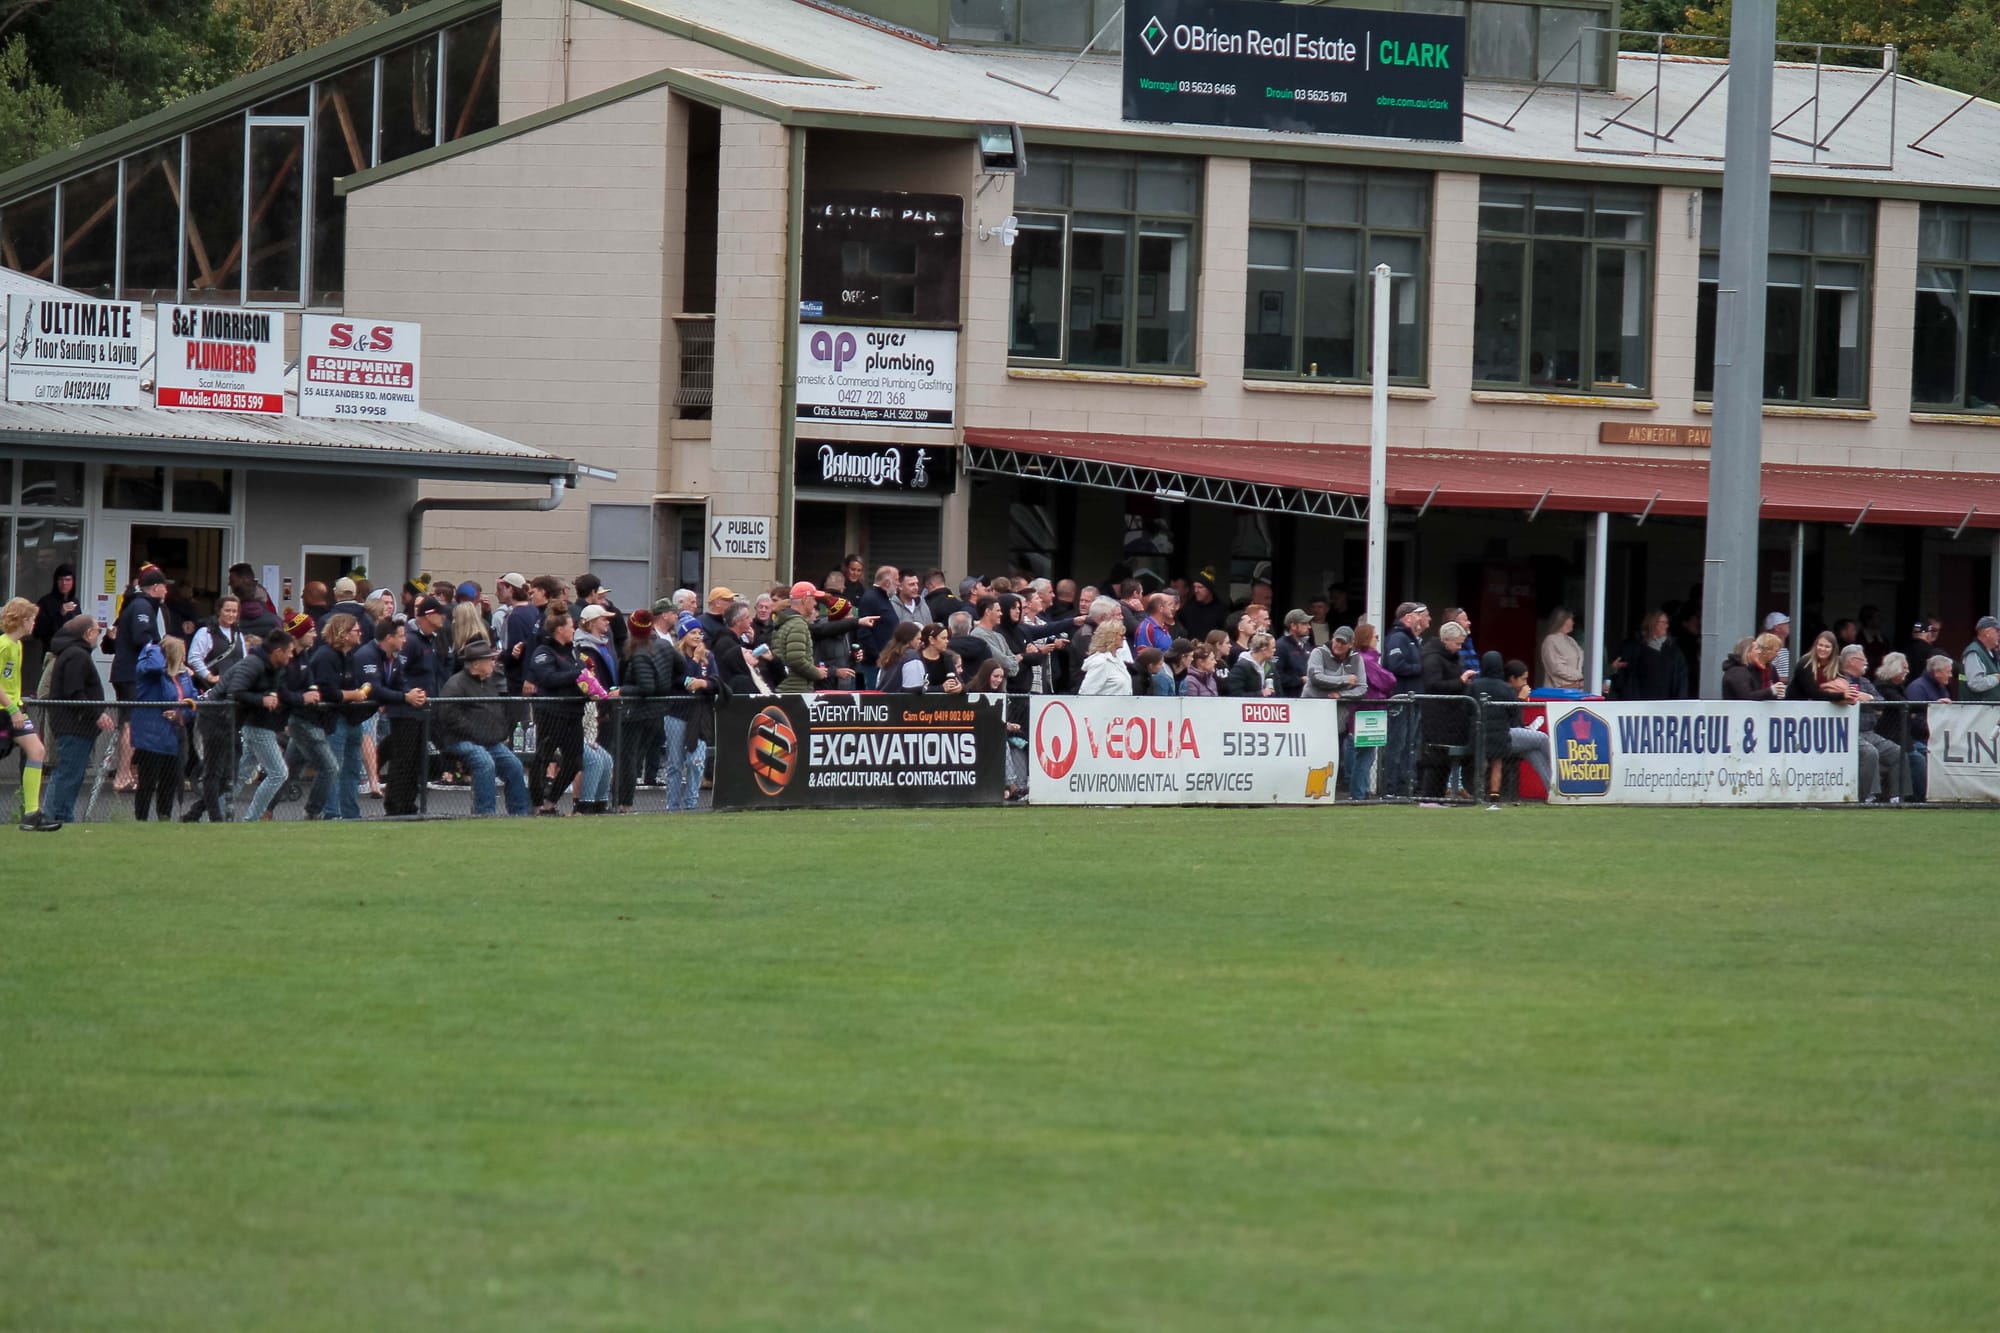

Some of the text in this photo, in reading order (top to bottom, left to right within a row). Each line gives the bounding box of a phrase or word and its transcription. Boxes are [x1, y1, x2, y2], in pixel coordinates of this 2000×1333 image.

[1174, 24, 1356, 62] OBrien Real Estate
[1379, 39, 1450, 69] CLARK
[1139, 78, 1236, 95] Warragul 03 5623 6466
[1266, 87, 1348, 103] Drouin 03 5625 1671
[1376, 95, 1449, 109] obre.com.au/clark
[40, 301, 131, 338] ULTIMATE
[172, 307, 270, 343] S&F MORRISON
[866, 331, 906, 350] ayres
[35, 338, 137, 365] Floor Sanding & Laying
[186, 340, 256, 374] PLUMBERS
[810, 330, 857, 372] ap
[316, 358, 403, 373] EQUIPMENT
[865, 352, 934, 376] plumbing
[215, 380, 245, 390] Morrison
[310, 369, 410, 386] HIRE & SALES
[796, 375, 953, 393] omestic & Commercial Plumbing Gasfitting
[35, 385, 45, 398] Call
[63, 380, 111, 401] 0419234424
[304, 387, 313, 396] 55
[315, 388, 364, 399] ALEXANDERS
[379, 392, 415, 402] MORWELL
[838, 389, 906, 406] 0427 221 368
[179, 391, 263, 409] Mobile: 0418 515 599
[335, 404, 387, 416] 5133 9958
[813, 405, 830, 416] Chris
[830, 406, 837, 416] &
[861, 408, 878, 419] Ayres
[1627, 426, 1677, 442] ANSWERTH
[833, 476, 867, 484] BREWING
[728, 521, 764, 535] PUBLIC
[725, 540, 766, 554] TOILETS
[809, 705, 975, 724] EVERYTHING Cam Guy 0419 002 069
[1244, 705, 1287, 721] PHONE
[1617, 715, 1849, 754] WARRAGUL & DROUIN
[809, 733, 976, 766] EXCAVATIONS
[1223, 732, 1307, 757] 5133 7111
[1566, 739, 1598, 761] Best
[1558, 758, 1610, 780] Western
[897, 771, 977, 787] CONTRACTING
[1069, 772, 1253, 793] ENVIRONMENTAL SERVICES
[1623, 767, 1844, 792] Independenty Owned & Operated
